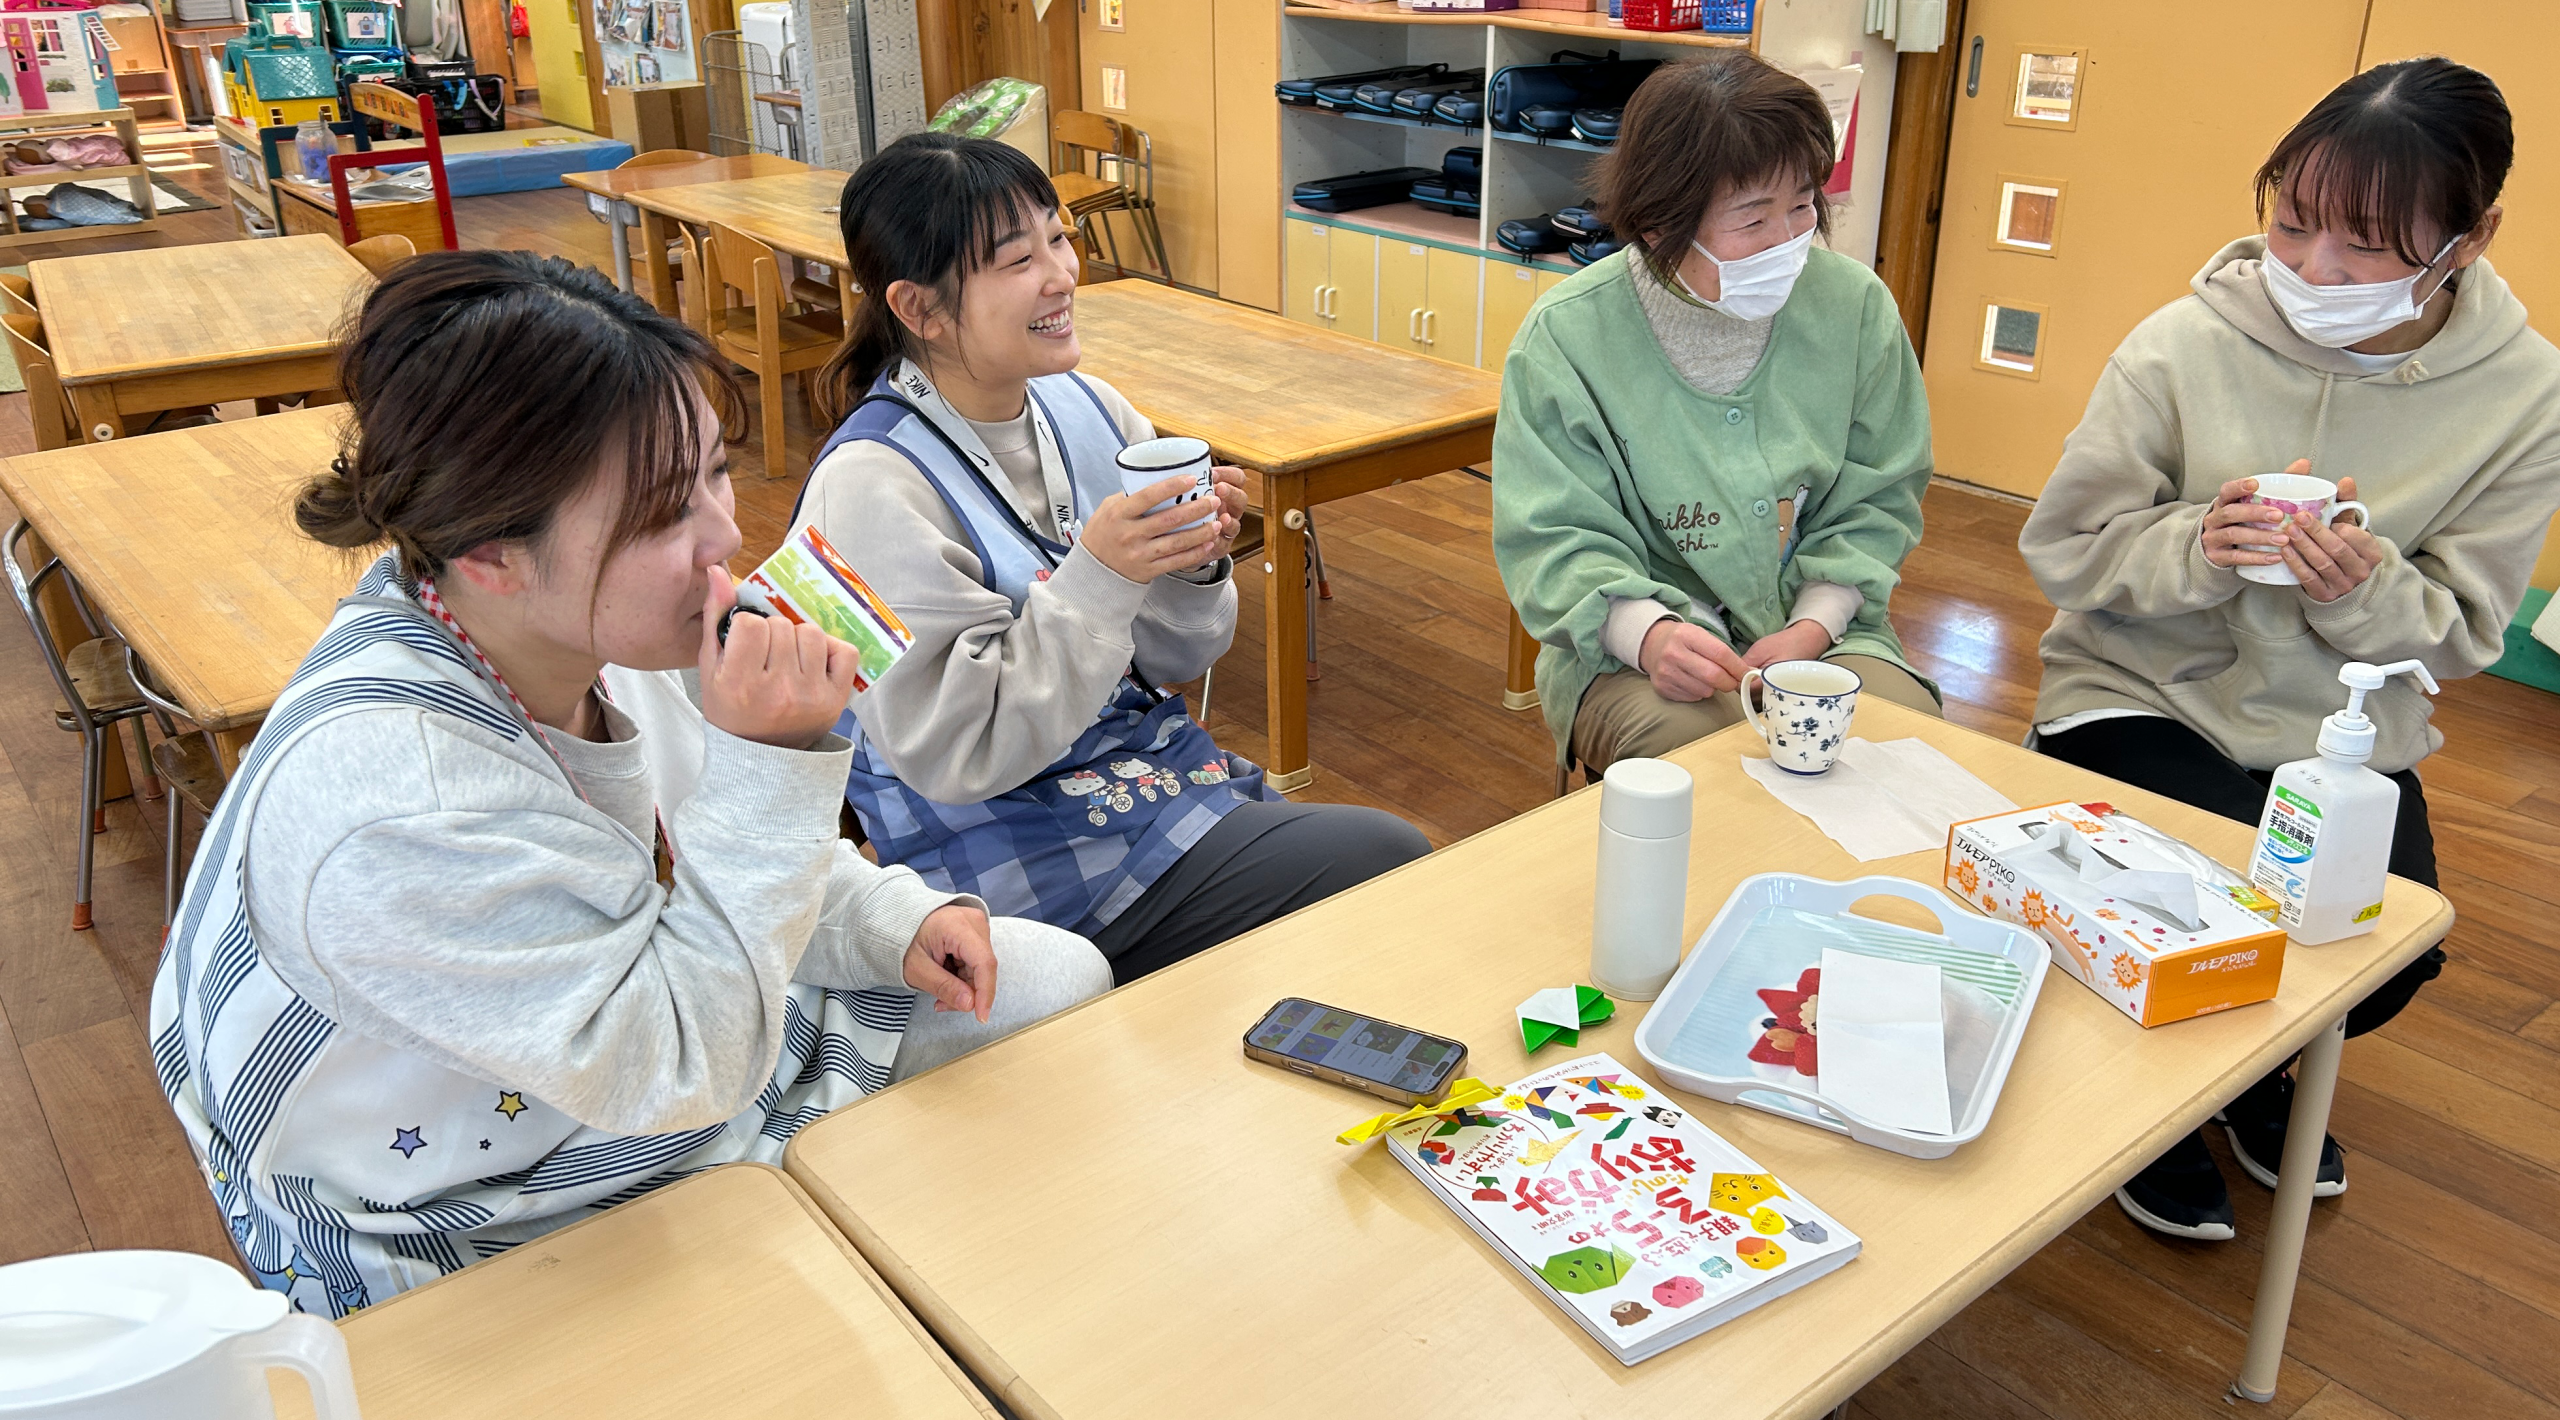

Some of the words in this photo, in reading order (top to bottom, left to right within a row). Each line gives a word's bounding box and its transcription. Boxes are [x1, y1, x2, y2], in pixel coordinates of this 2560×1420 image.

[905, 374, 930, 398] NIKE
[1056, 504, 1071, 537] NIK
[2285, 793, 2311, 811] SARAYA
[2269, 814, 2314, 848] 手指消毒剤
[1989, 859, 2015, 883] PIKO
[2229, 949, 2258, 966] PIKO
[1456, 1123, 1525, 1181] わかりやすい
[1512, 1136, 1696, 1217] おりがみ
[1641, 1215, 1741, 1267] 親子で遊べる
